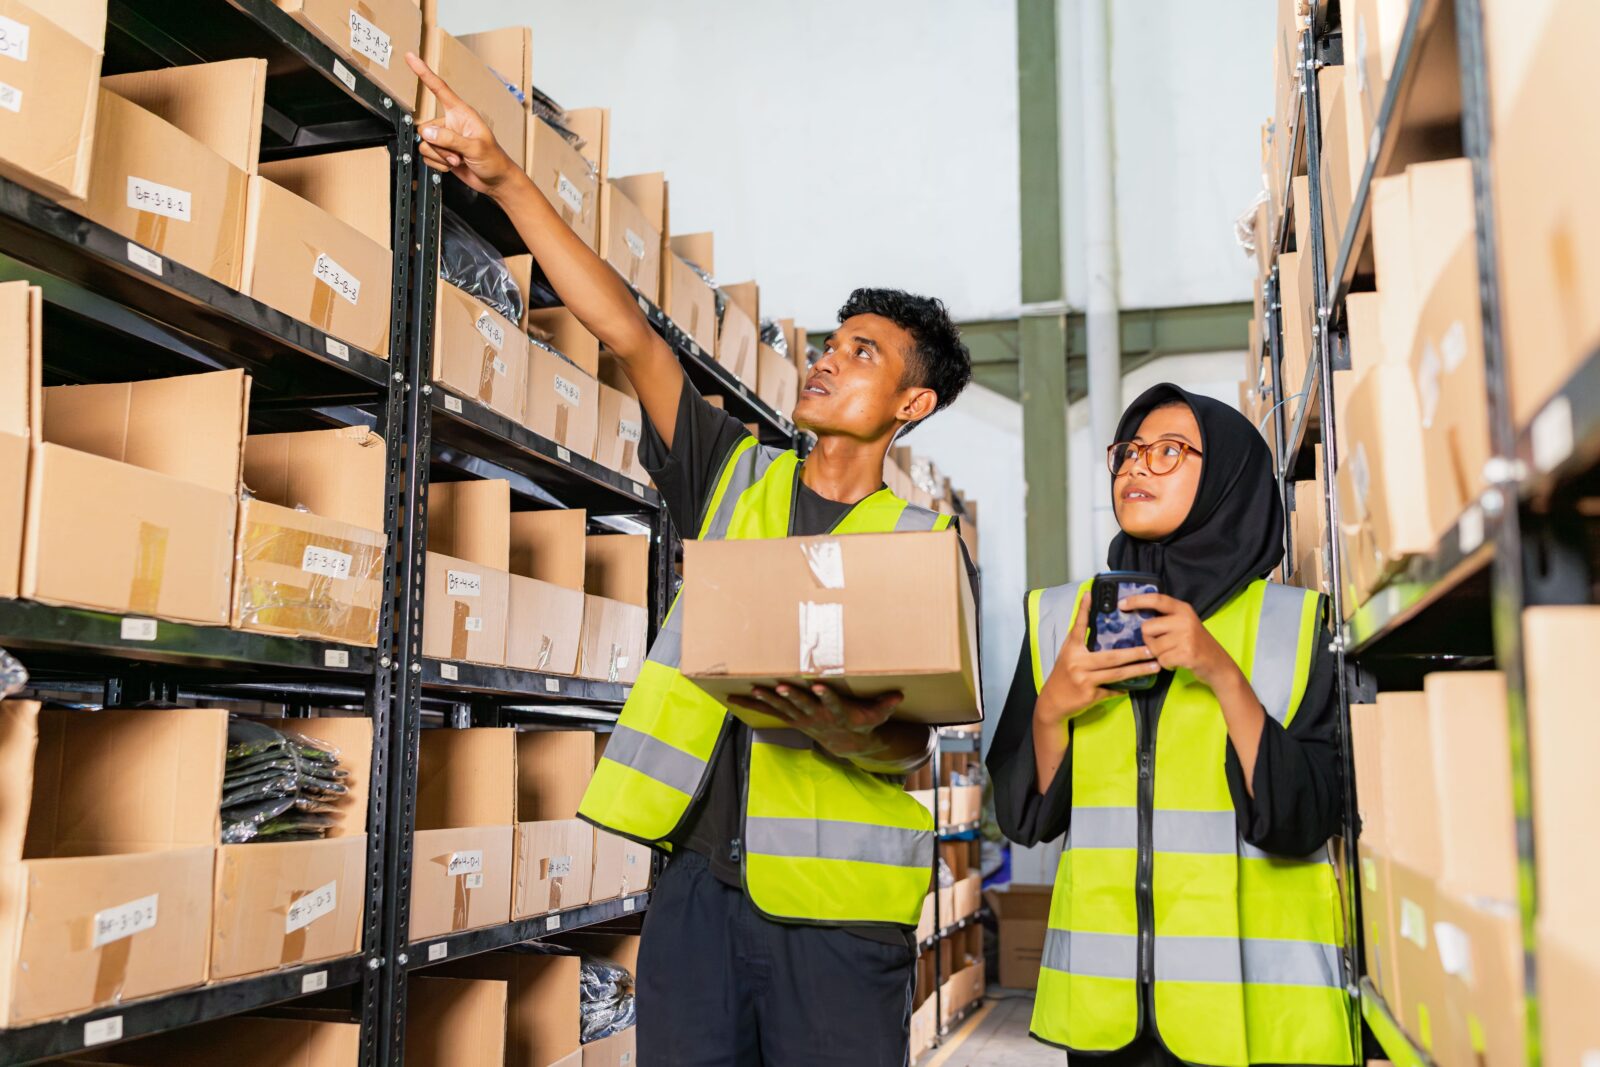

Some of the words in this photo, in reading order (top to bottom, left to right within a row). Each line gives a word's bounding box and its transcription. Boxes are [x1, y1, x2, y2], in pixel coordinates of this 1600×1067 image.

[351, 14, 388, 54] BF-3-A-3
[135, 185, 184, 212] BF-3-B-2
[317, 257, 357, 301] BF-3-B-3
